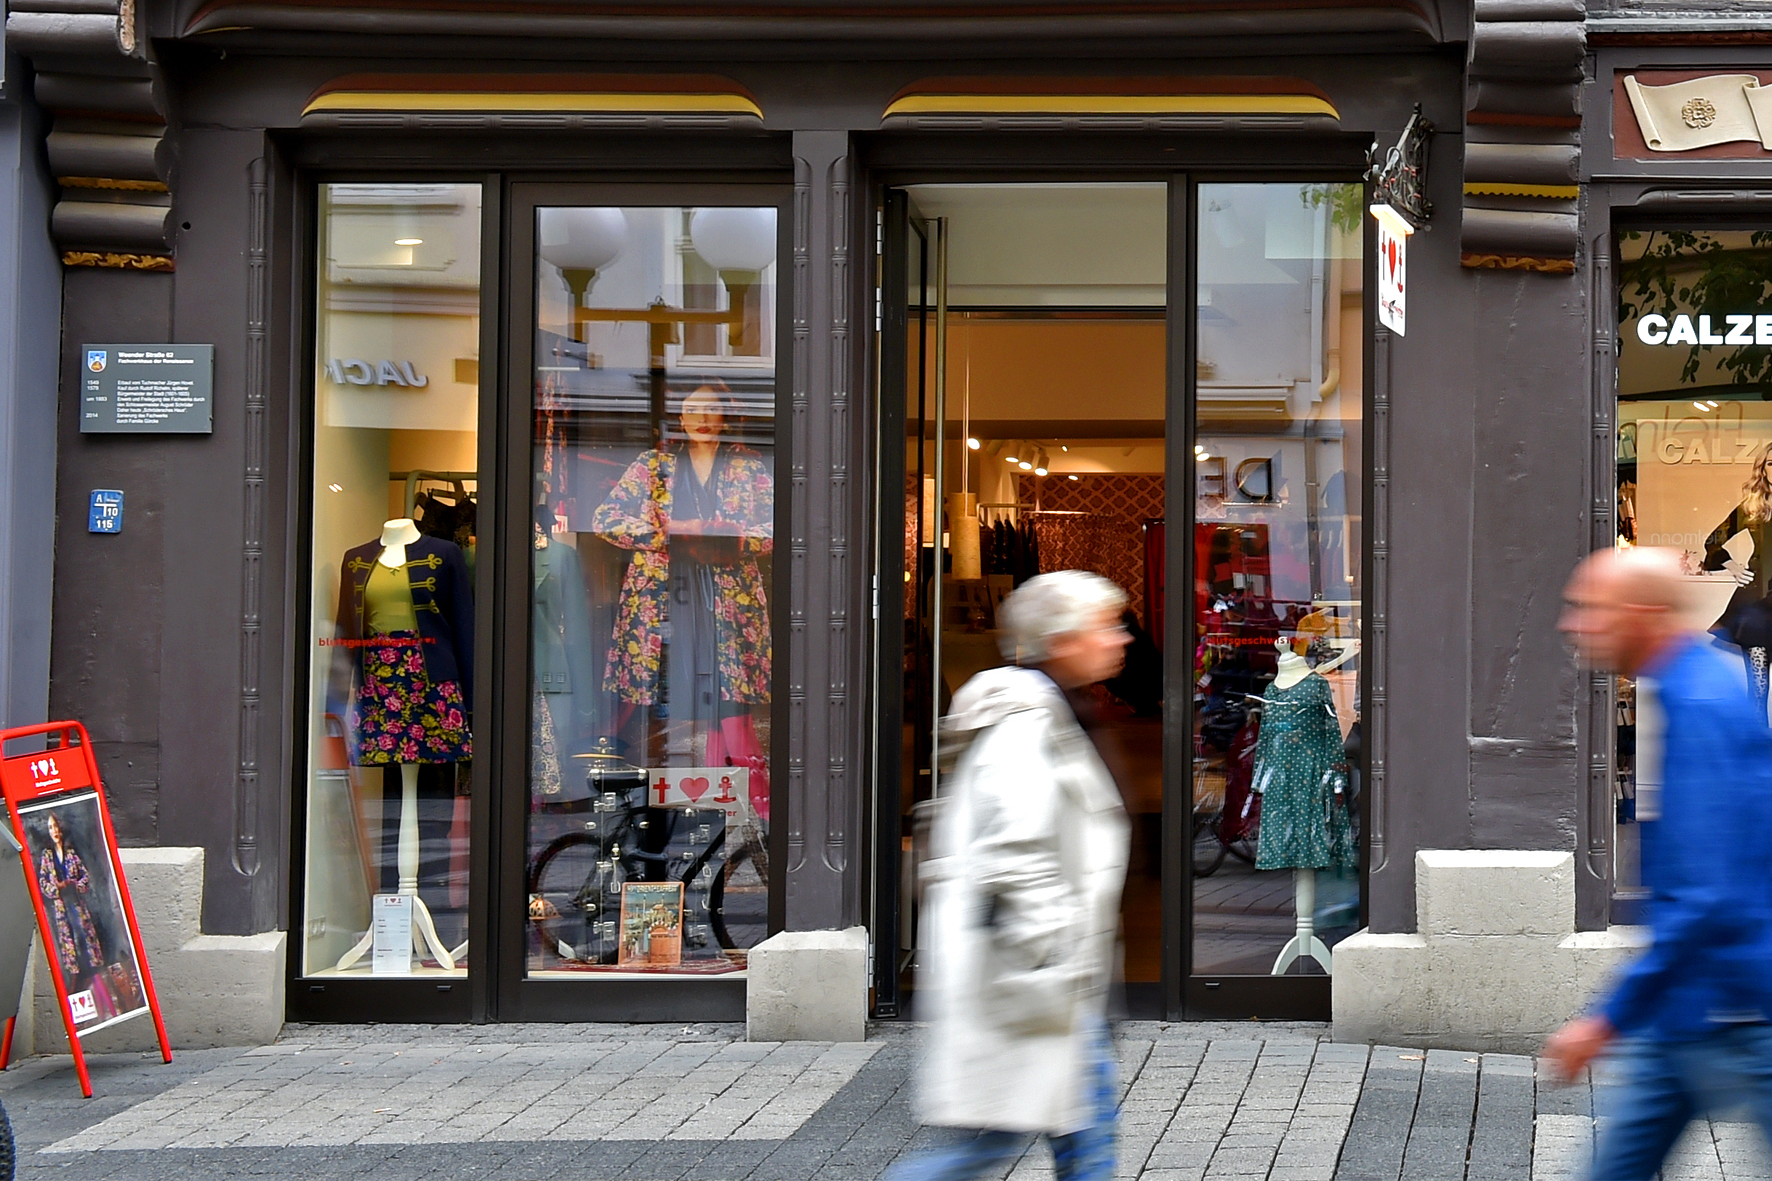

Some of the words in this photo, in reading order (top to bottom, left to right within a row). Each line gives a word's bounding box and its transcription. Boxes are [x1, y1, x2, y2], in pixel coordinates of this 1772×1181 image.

[96, 494, 103, 503] A
[107, 508, 118, 516] 10
[97, 520, 113, 529] 115
